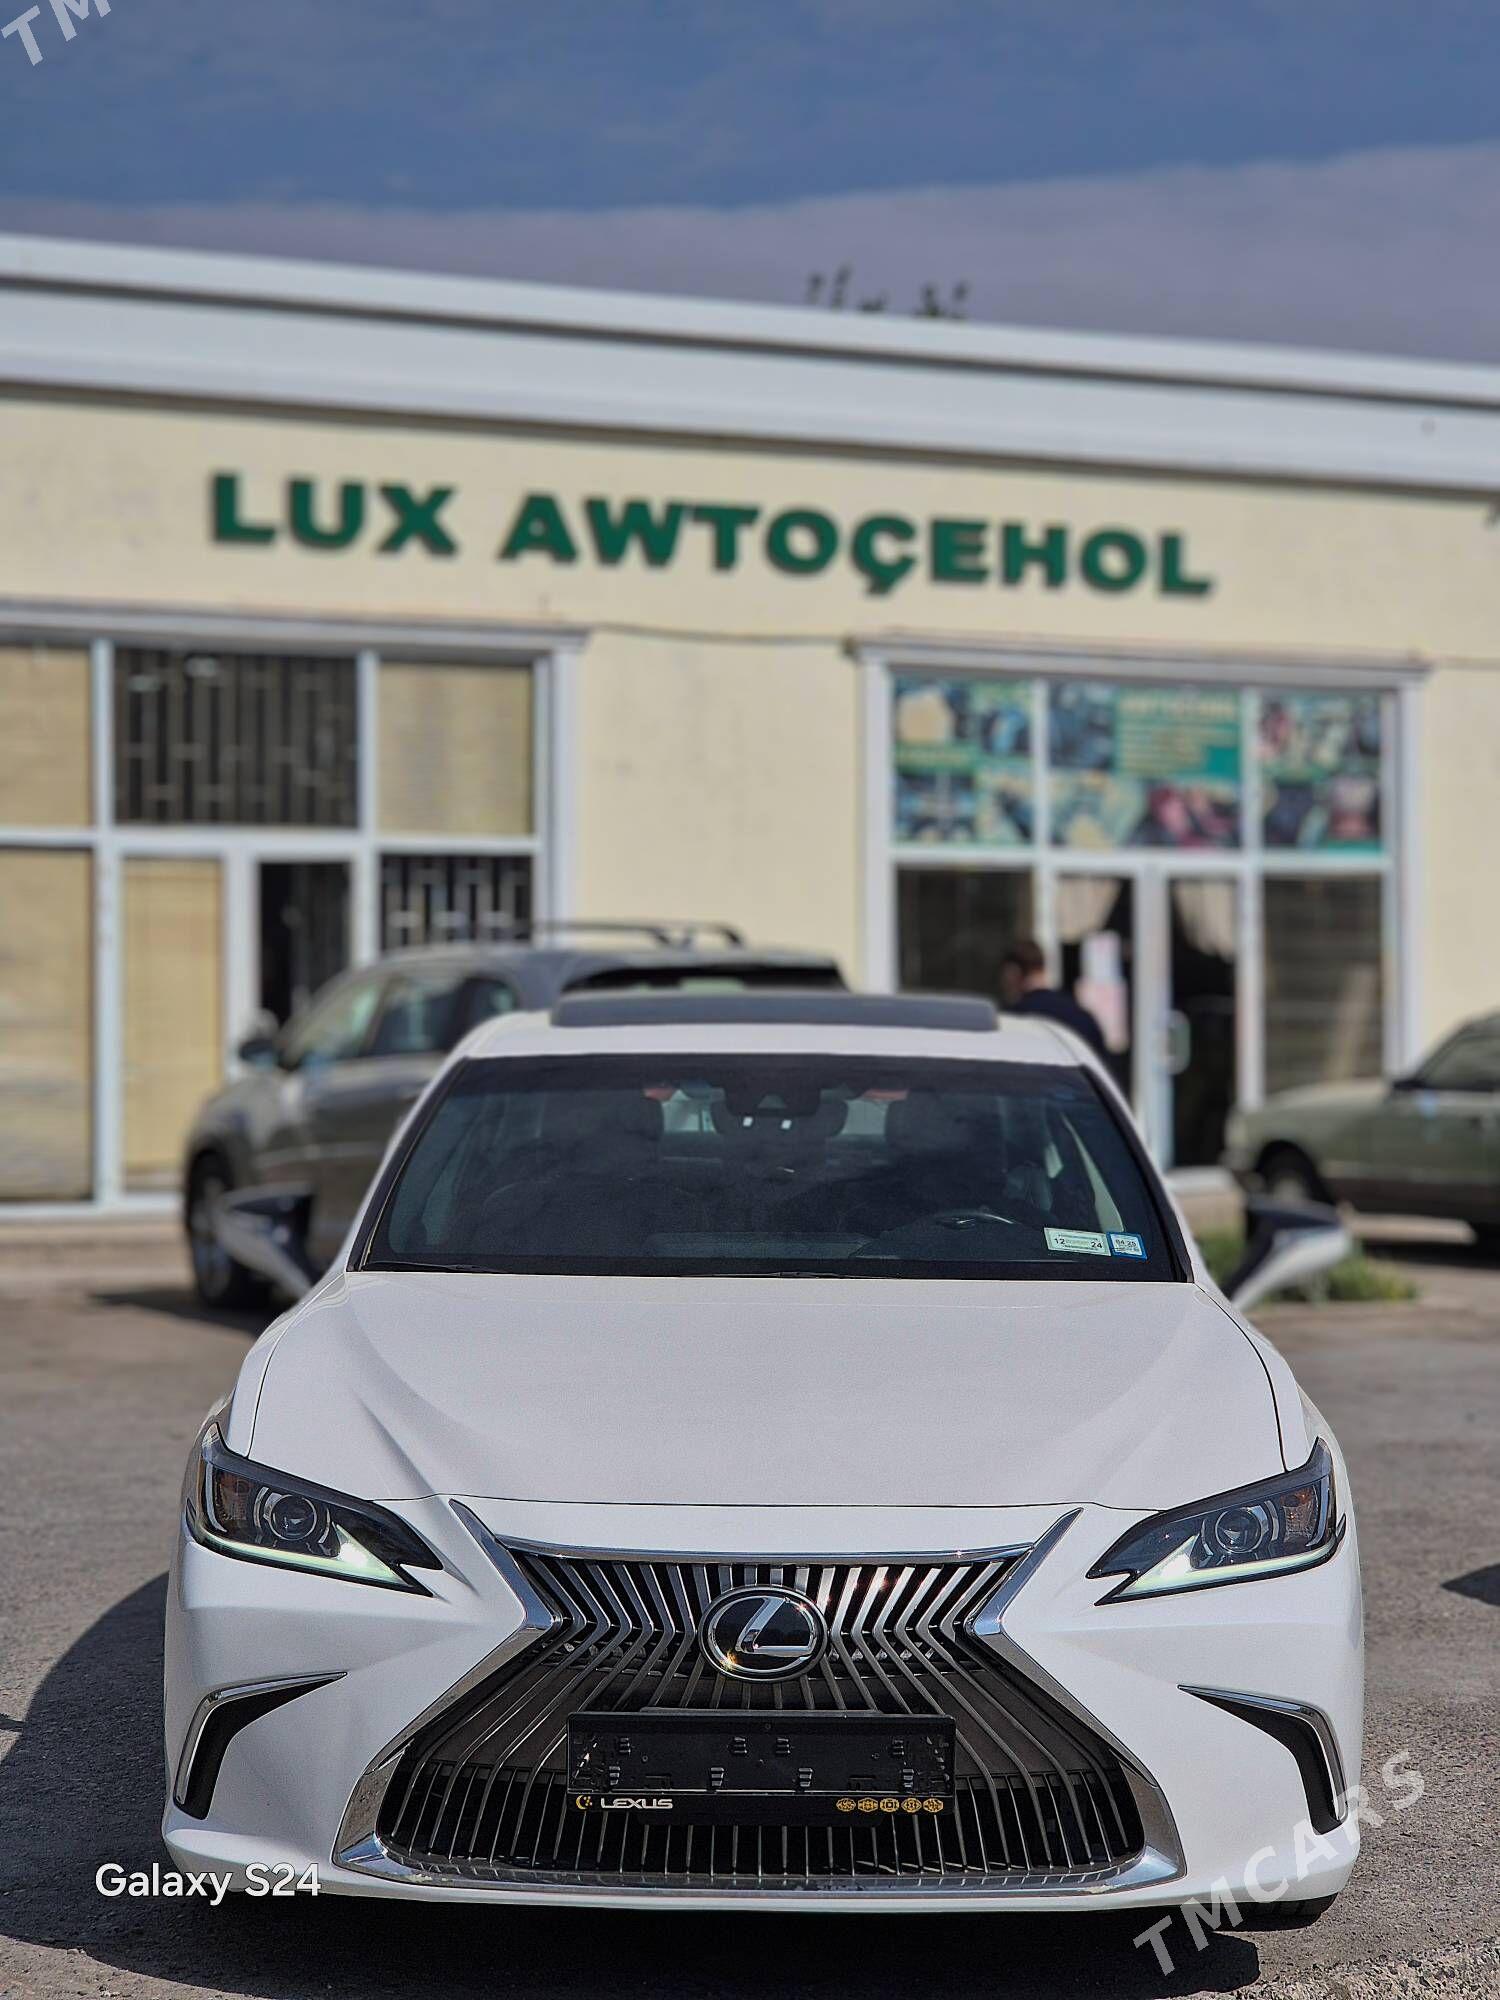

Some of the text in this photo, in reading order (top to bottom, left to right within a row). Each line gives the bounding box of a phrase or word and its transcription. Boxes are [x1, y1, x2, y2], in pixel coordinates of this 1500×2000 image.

[212, 471, 1213, 596] LUX AWTOÇEHOL
[1091, 1241, 1103, 1249] 24
[600, 1797, 674, 1810] LEXUS
